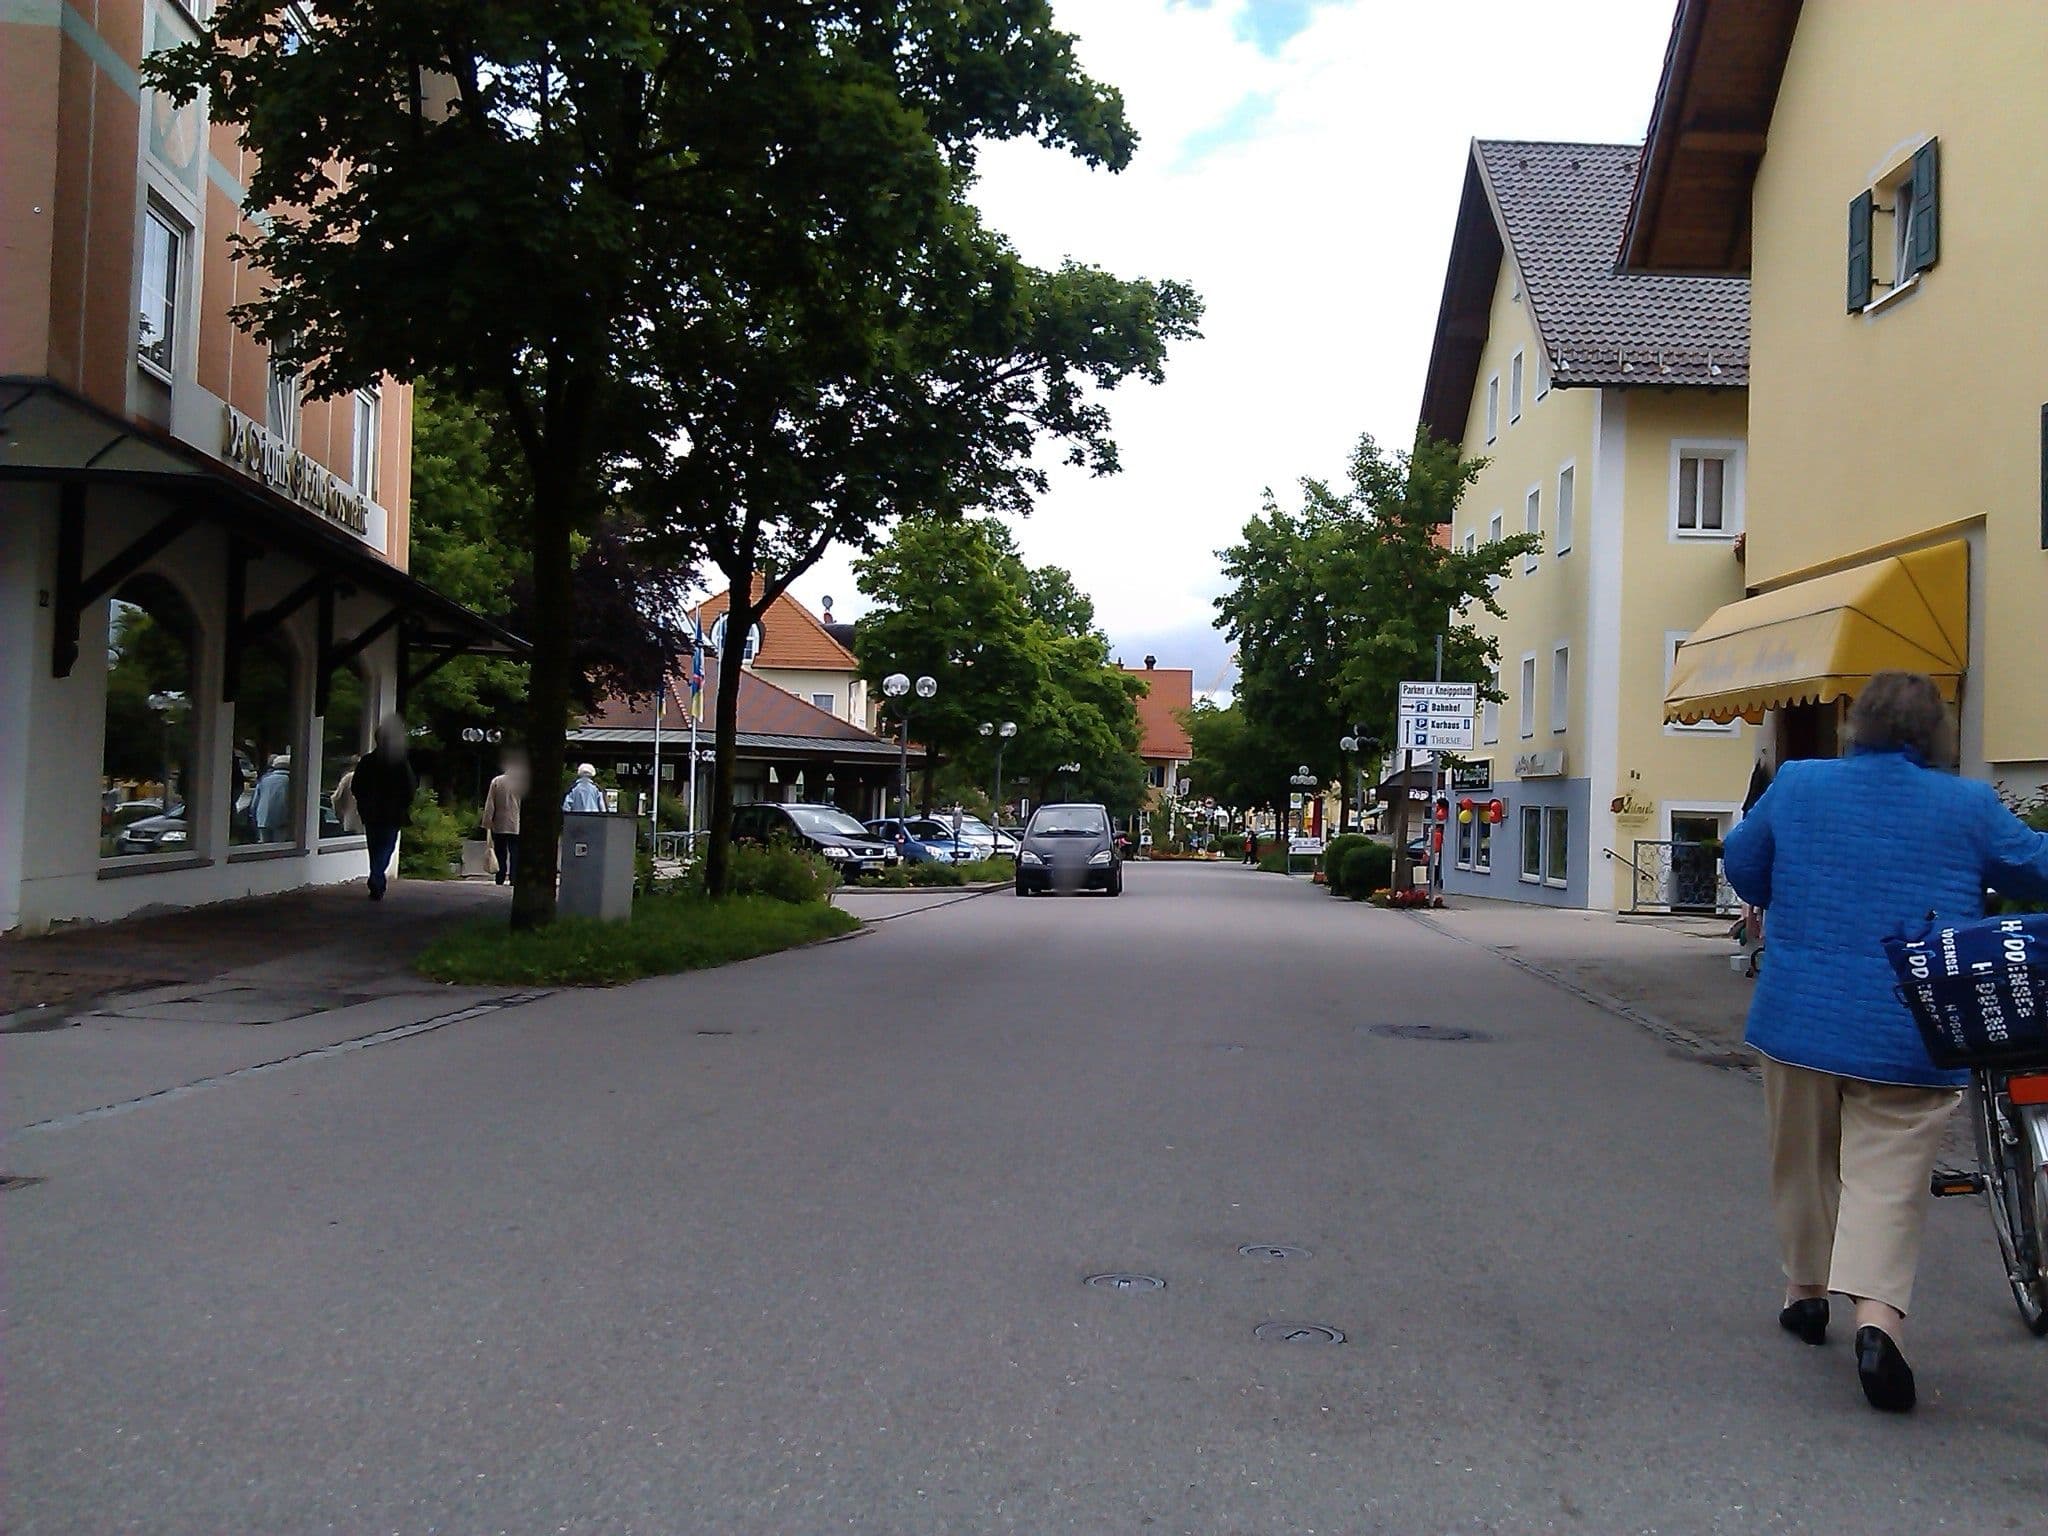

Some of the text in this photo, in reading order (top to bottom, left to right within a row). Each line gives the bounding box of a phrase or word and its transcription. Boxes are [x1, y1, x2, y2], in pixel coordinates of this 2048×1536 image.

[1403, 685, 1425, 695] Parken
[1435, 686, 1473, 697] Kneippstadt
[1431, 703, 1461, 712] Bahnhof
[1431, 720, 1460, 730] Kurhaus
